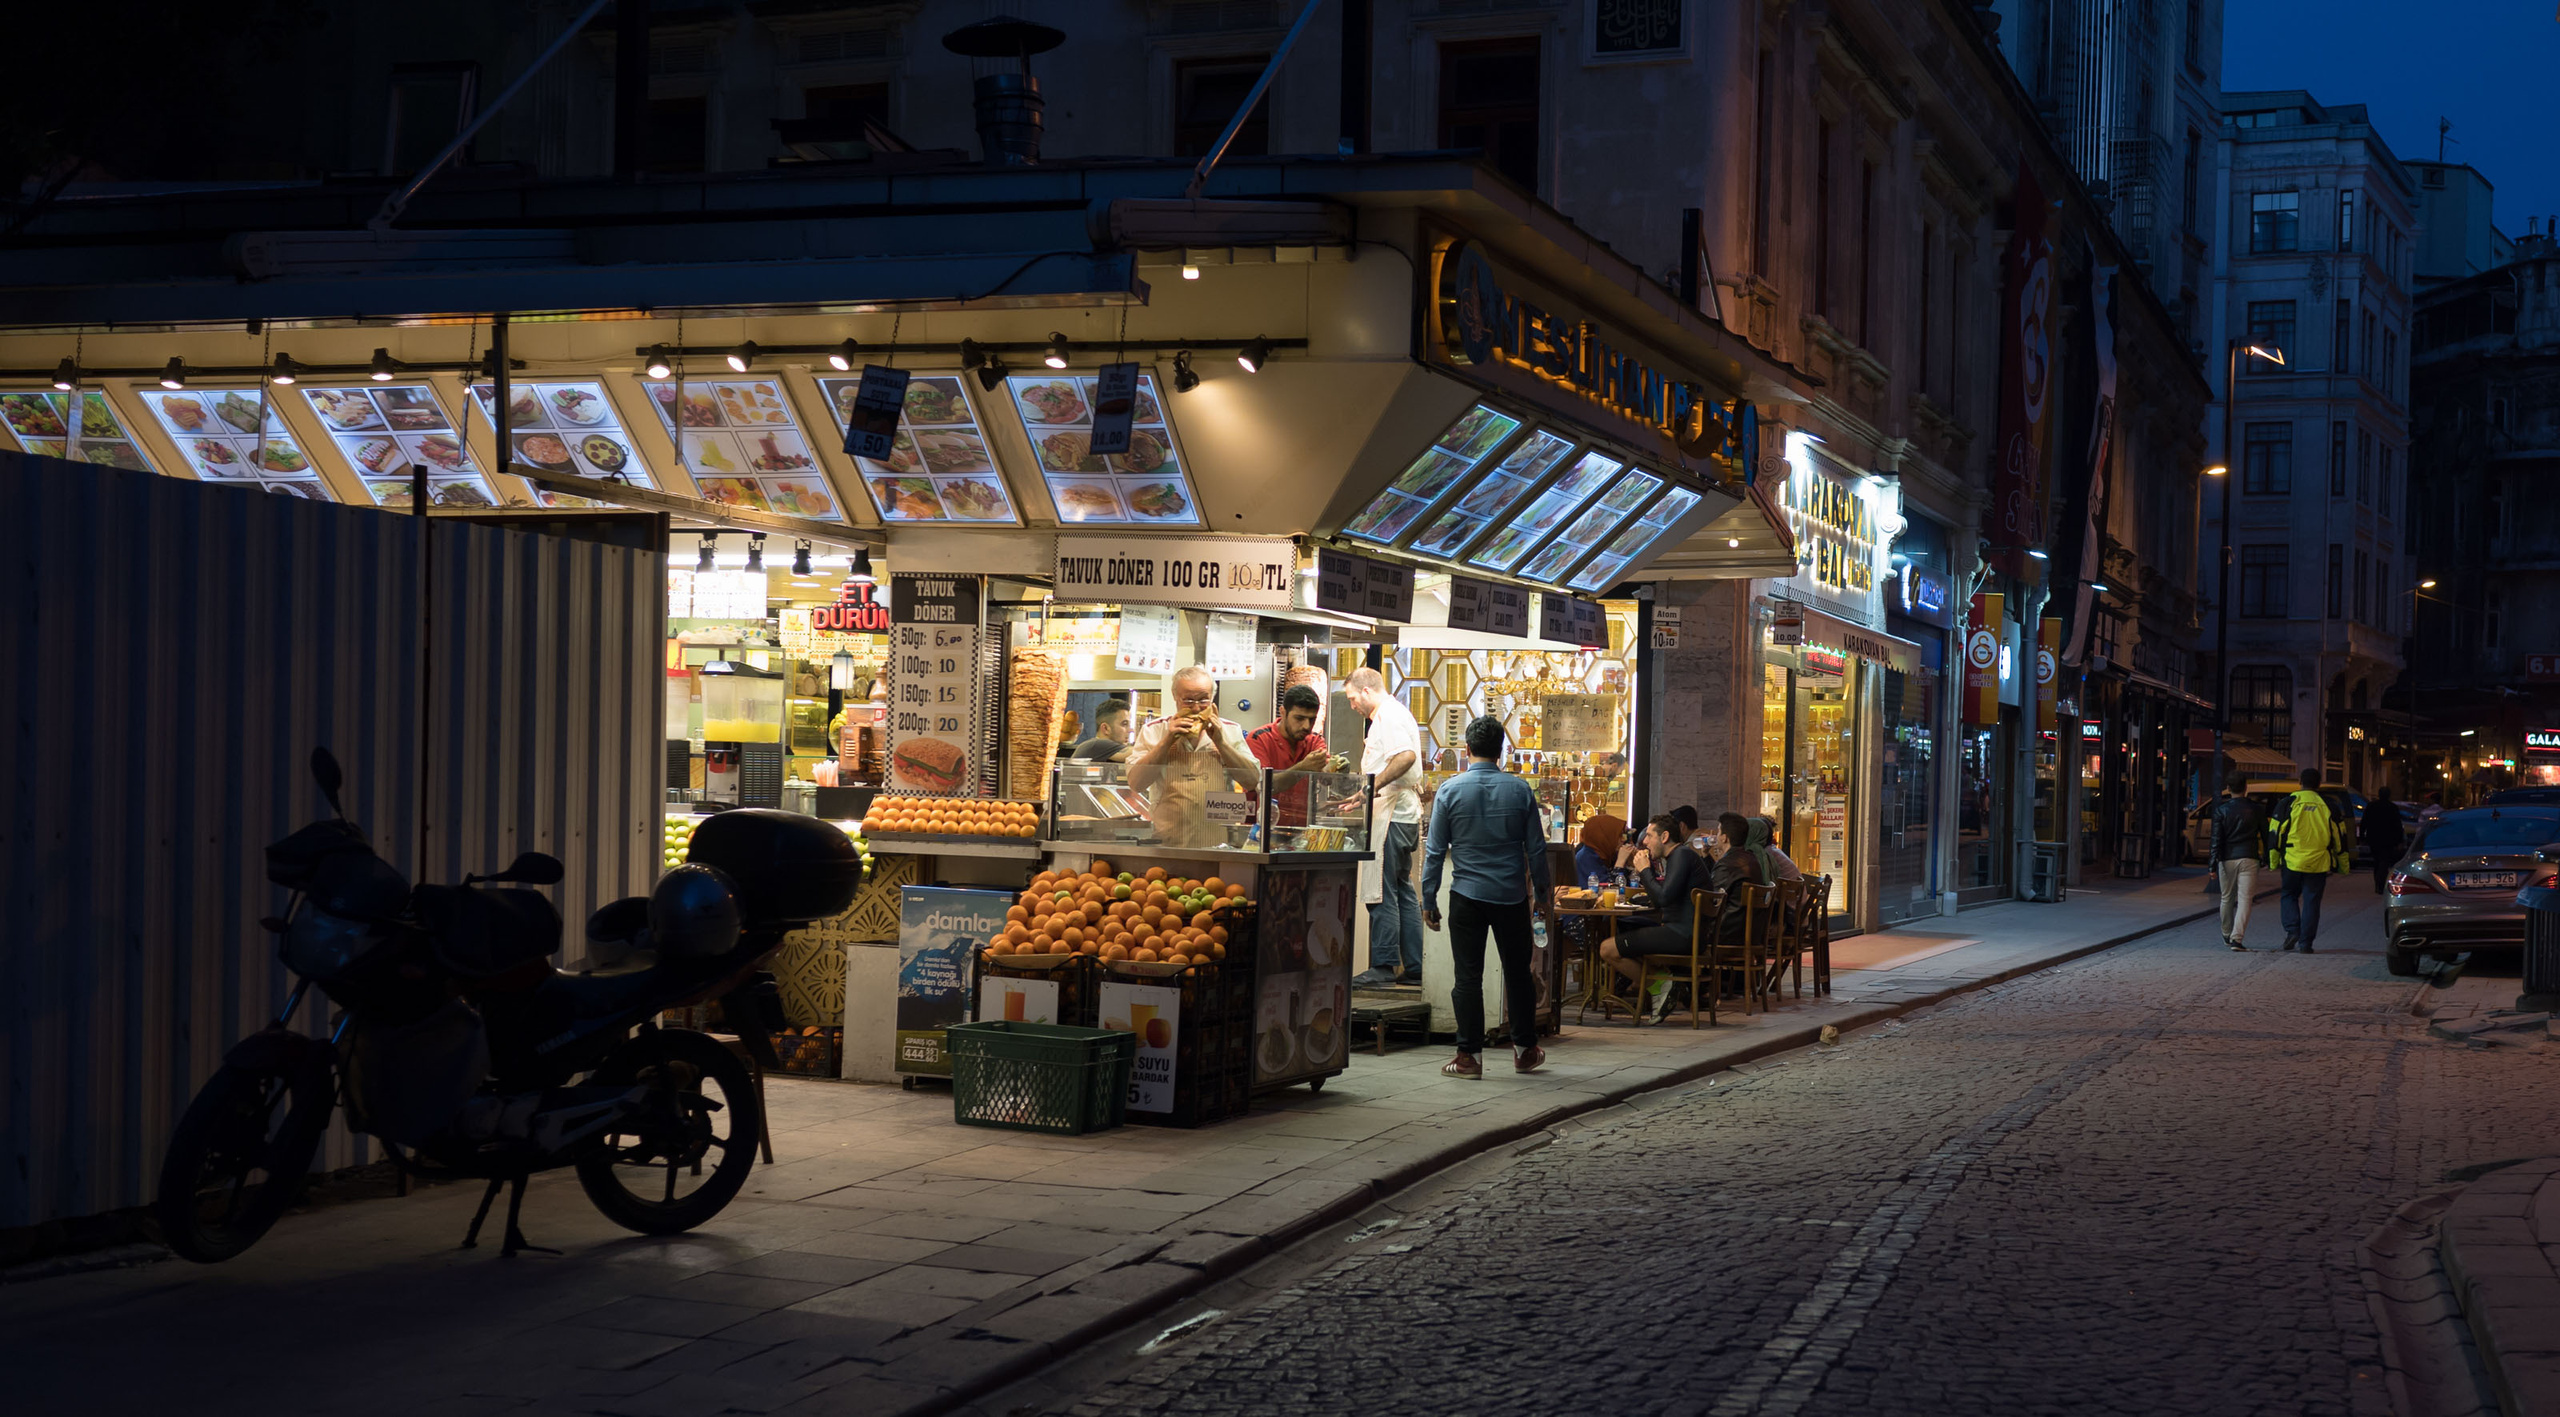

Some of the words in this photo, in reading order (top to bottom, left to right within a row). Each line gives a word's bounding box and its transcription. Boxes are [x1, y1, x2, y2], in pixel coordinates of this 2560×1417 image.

[1060, 557, 1103, 584] TAVUK
[1107, 552, 1154, 586] DÖNER
[1162, 561, 1192, 587] 100
[1199, 562, 1220, 588] GR
[1265, 564, 1286, 591] TL
[841, 582, 873, 604] ET
[915, 581, 956, 597] TAVUK
[914, 601, 956, 621] DÖNER
[901, 627, 927, 649] 50gr:
[1843, 633, 1880, 660] KARAKOVAN
[901, 657, 933, 678] 100gr:
[939, 659, 955, 673] 10
[900, 684, 931, 706] 150gr:
[938, 687, 957, 702] 15
[898, 712, 930, 735] 200gr:
[939, 718, 959, 732] 20
[1206, 800, 1246, 811] Metropol
[2496, 873, 2514, 883] 926
[926, 911, 990, 932] damla
[904, 1049, 925, 1059] 444
[1138, 1056, 1170, 1071] SUYU
[1132, 1071, 1169, 1084] BARDAK
